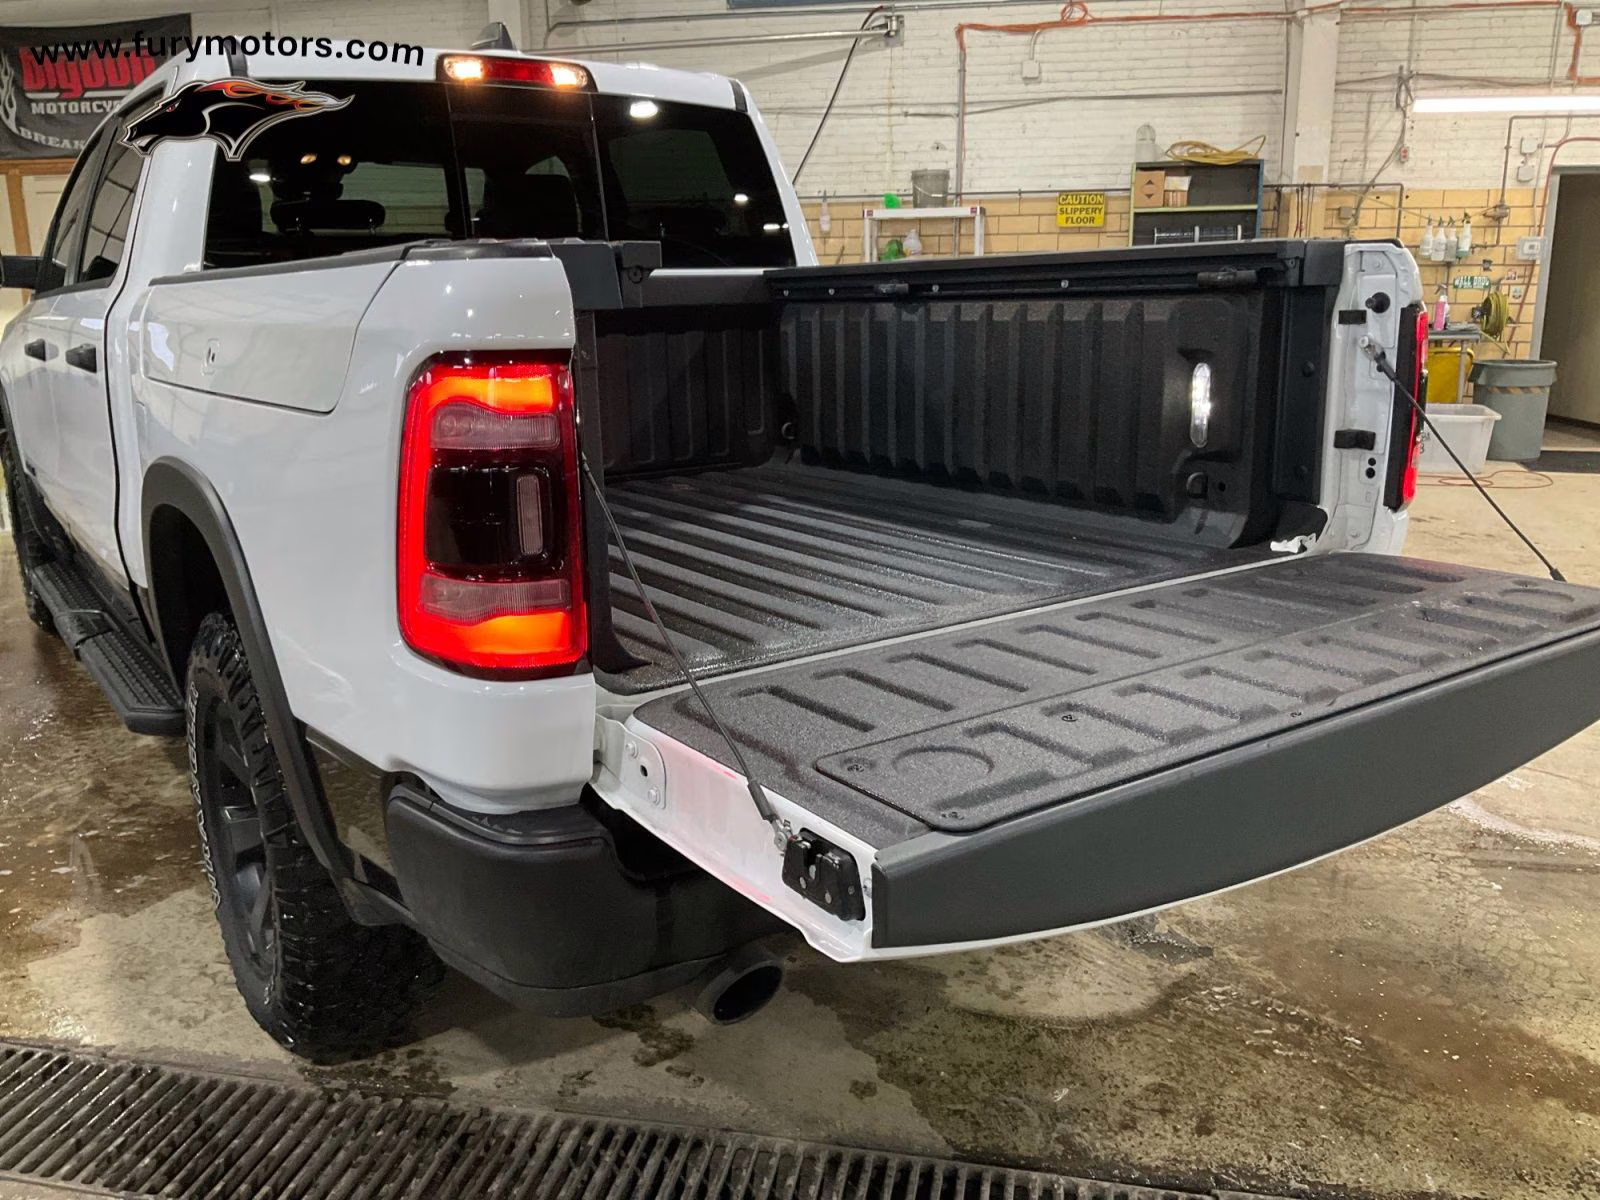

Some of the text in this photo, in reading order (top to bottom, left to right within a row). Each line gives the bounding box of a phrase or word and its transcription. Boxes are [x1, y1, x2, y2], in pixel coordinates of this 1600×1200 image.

[1059, 194, 1104, 205] CAUTION
[1059, 206, 1103, 215] SLIPPERY
[1066, 216, 1095, 225] FLOOR
